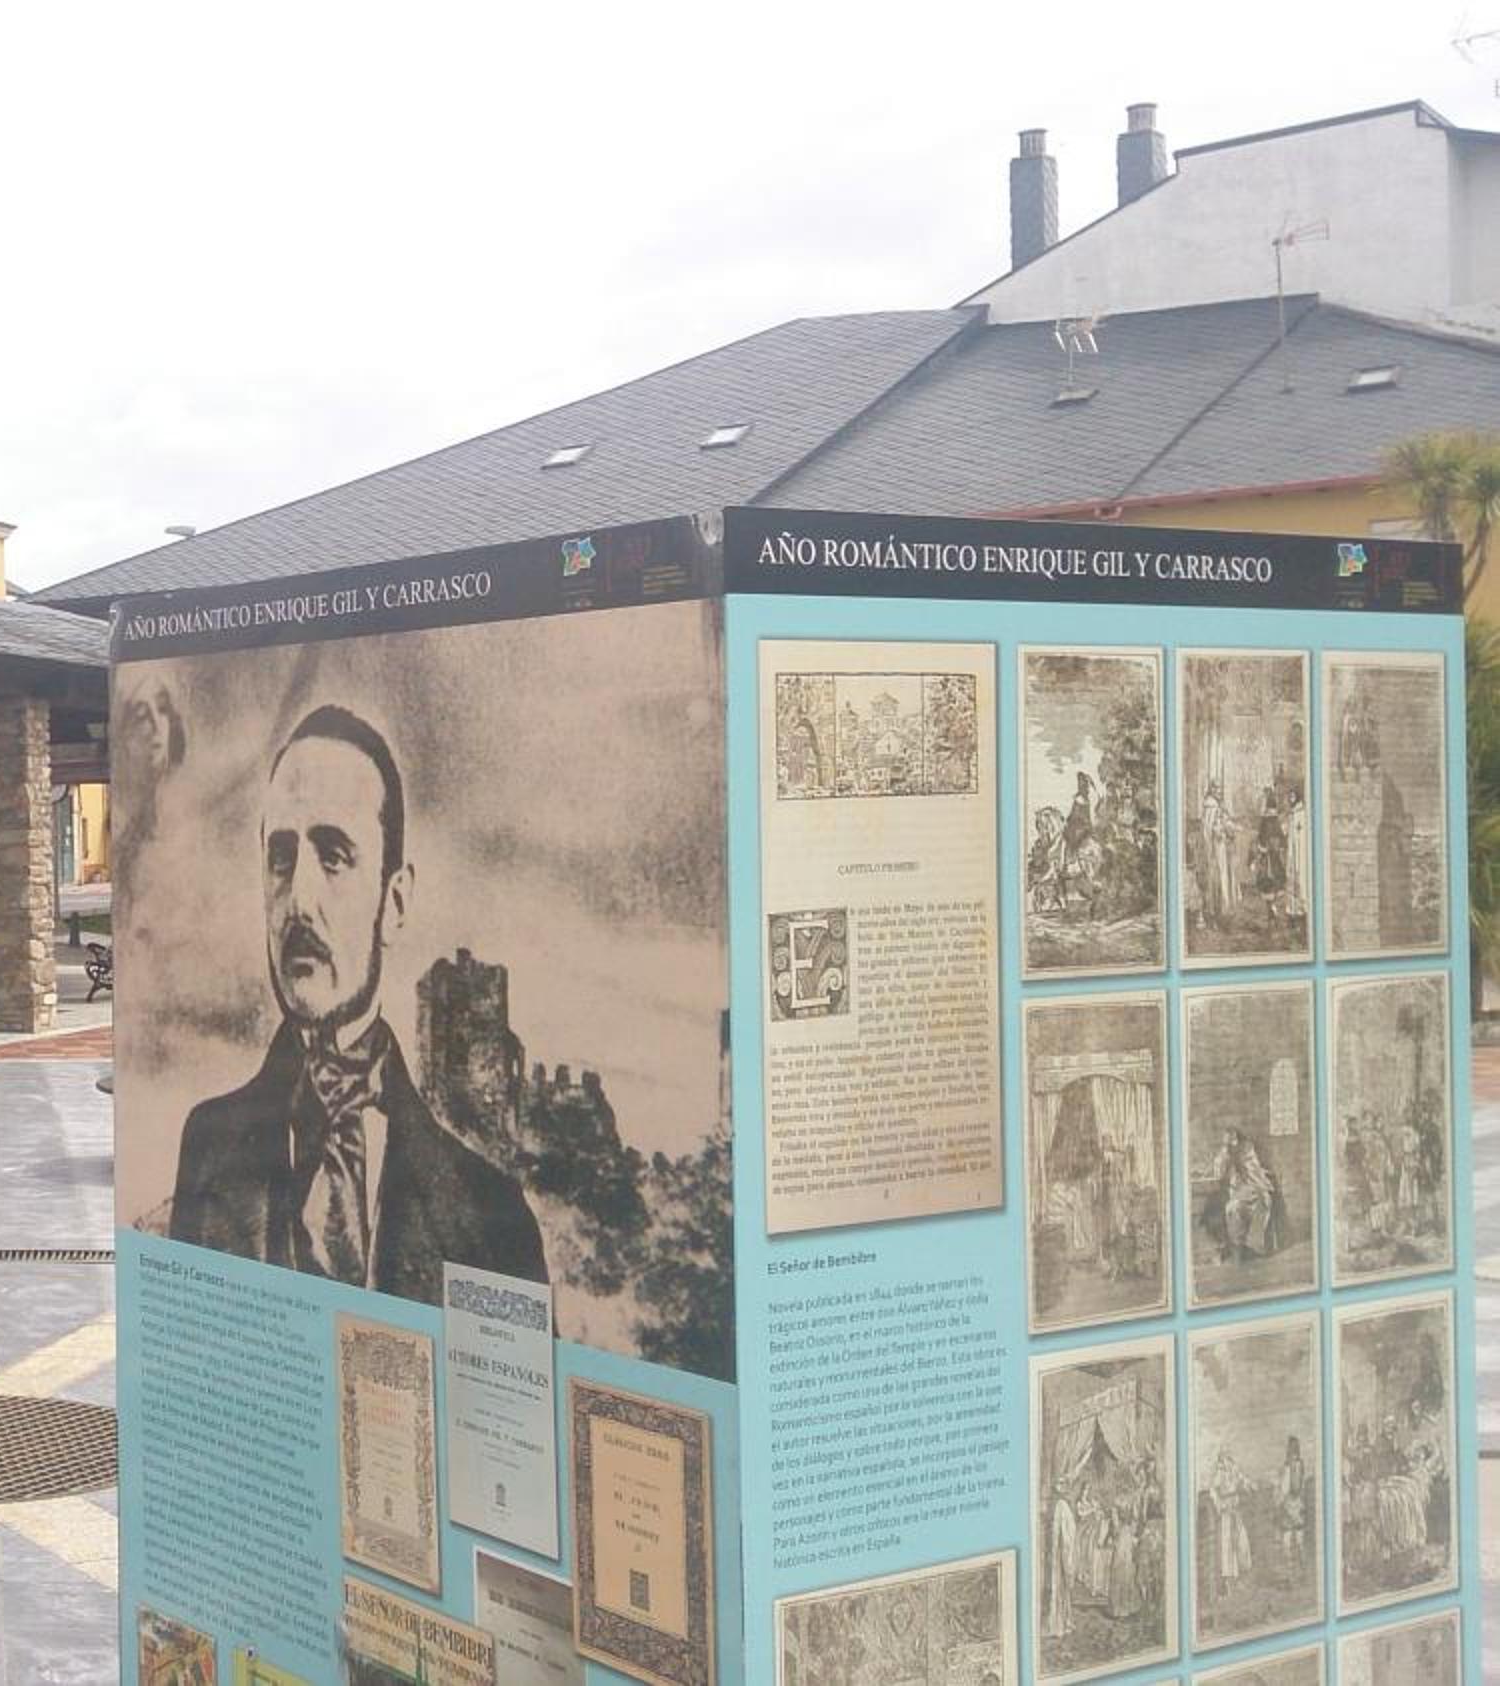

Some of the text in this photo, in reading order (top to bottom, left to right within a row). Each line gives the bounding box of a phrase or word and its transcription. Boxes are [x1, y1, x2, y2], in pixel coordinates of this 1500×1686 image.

[758, 531, 1272, 583] AÑO ROMÁNTICO ENRIQUE GIL Y CARRASCO
[124, 572, 491, 640] AÑO ROMÁNTICO ENRIQUE GIL Y CARRASCO
[767, 1251, 877, 1275] El Señor de Bembibre
